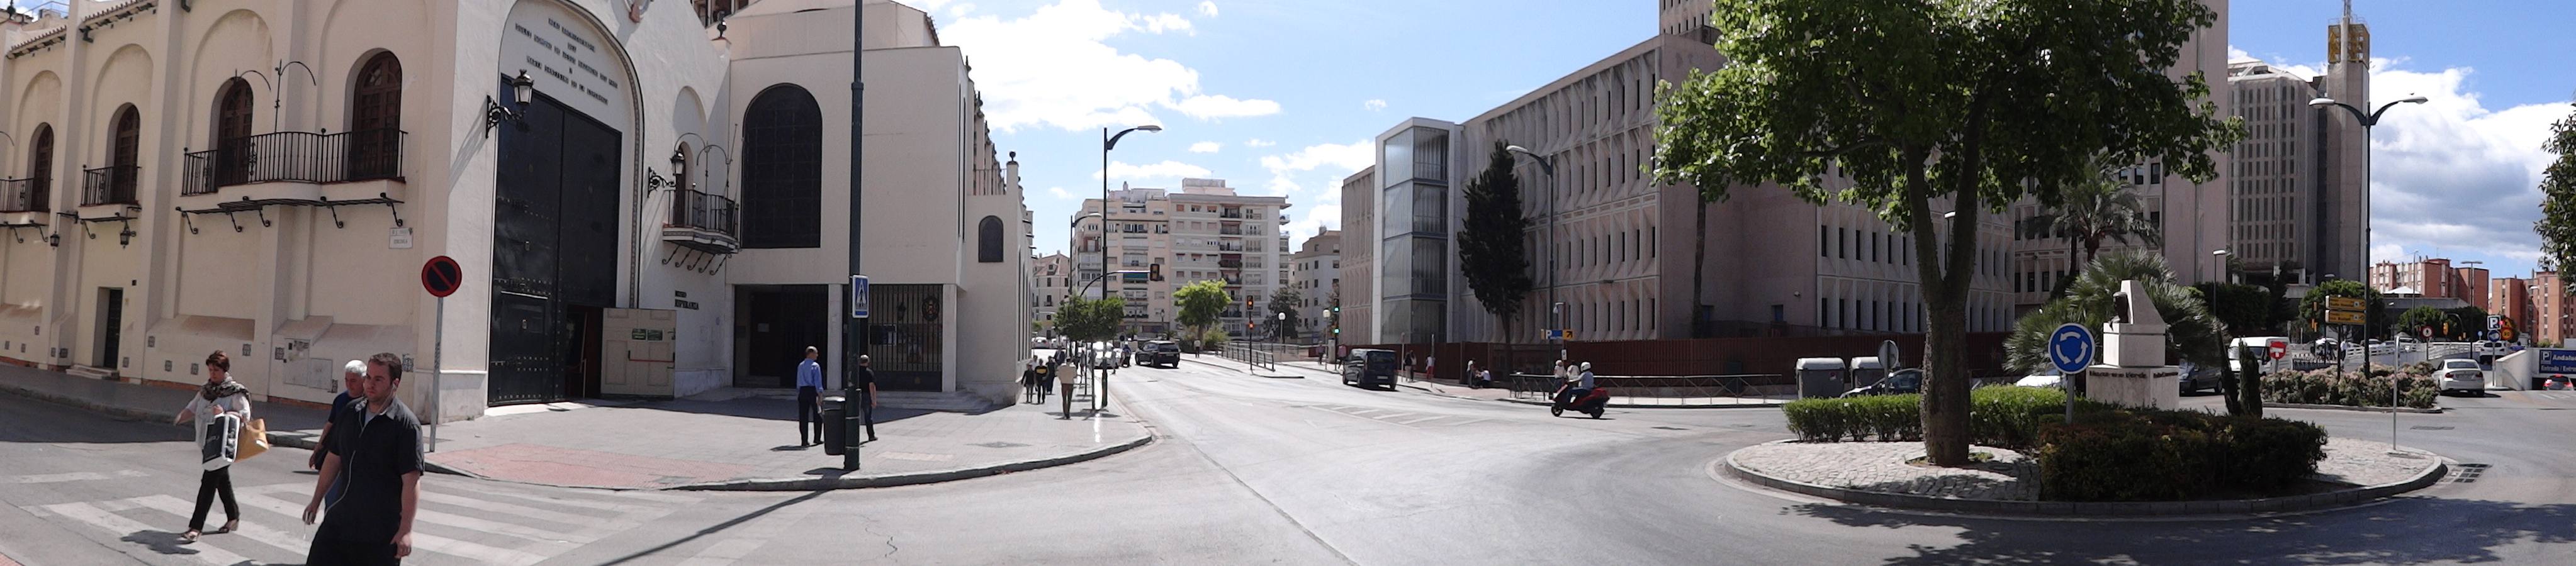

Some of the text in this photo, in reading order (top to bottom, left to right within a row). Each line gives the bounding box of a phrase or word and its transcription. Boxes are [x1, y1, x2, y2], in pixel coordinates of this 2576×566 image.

[2490, 318, 2498, 328] P
[1546, 330, 1552, 340] P
[2543, 352, 2550, 360] P
